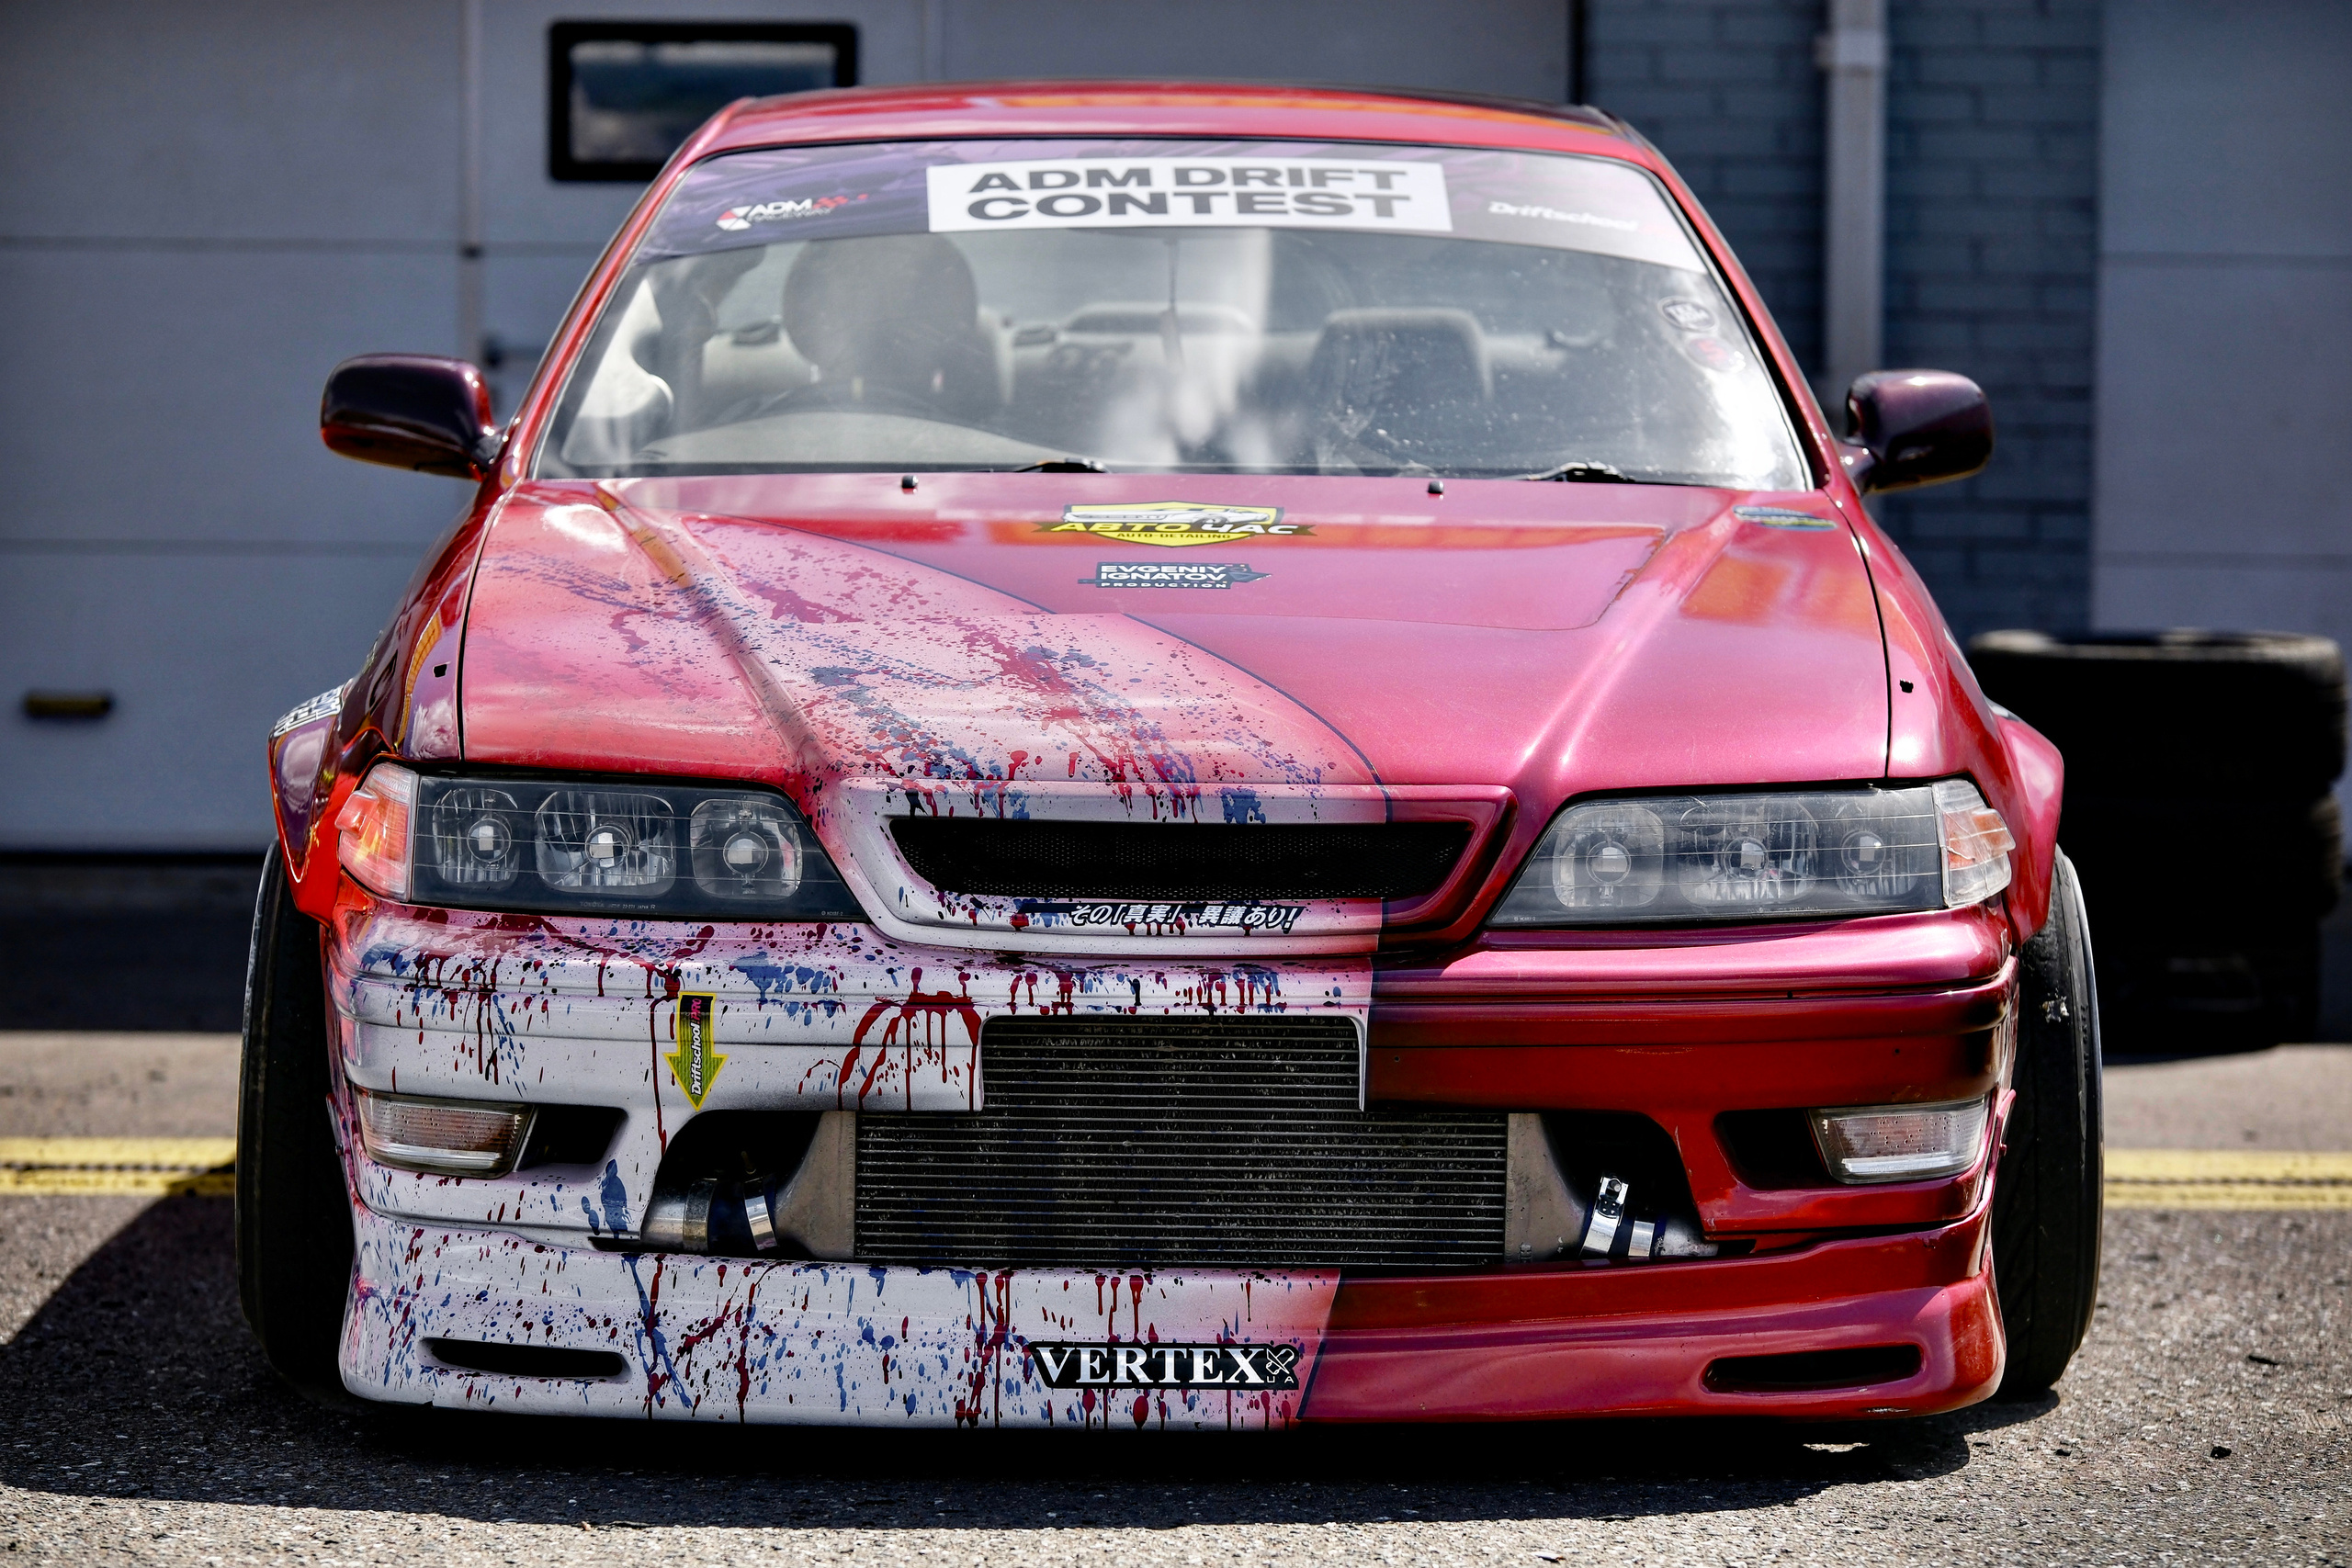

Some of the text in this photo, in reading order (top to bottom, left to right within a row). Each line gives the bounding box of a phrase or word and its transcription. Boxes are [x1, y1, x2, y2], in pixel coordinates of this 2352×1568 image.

[968, 166, 1408, 193] ADM DRIFT
[746, 197, 813, 223] ADM
[967, 191, 1411, 220] CONTEST
[1050, 522, 1299, 535] АВТО ЧАС
[1101, 565, 1227, 574] EVGENIY
[1101, 573, 1227, 581] IGNATOV
[1036, 1347, 1265, 1383] VERTEX
